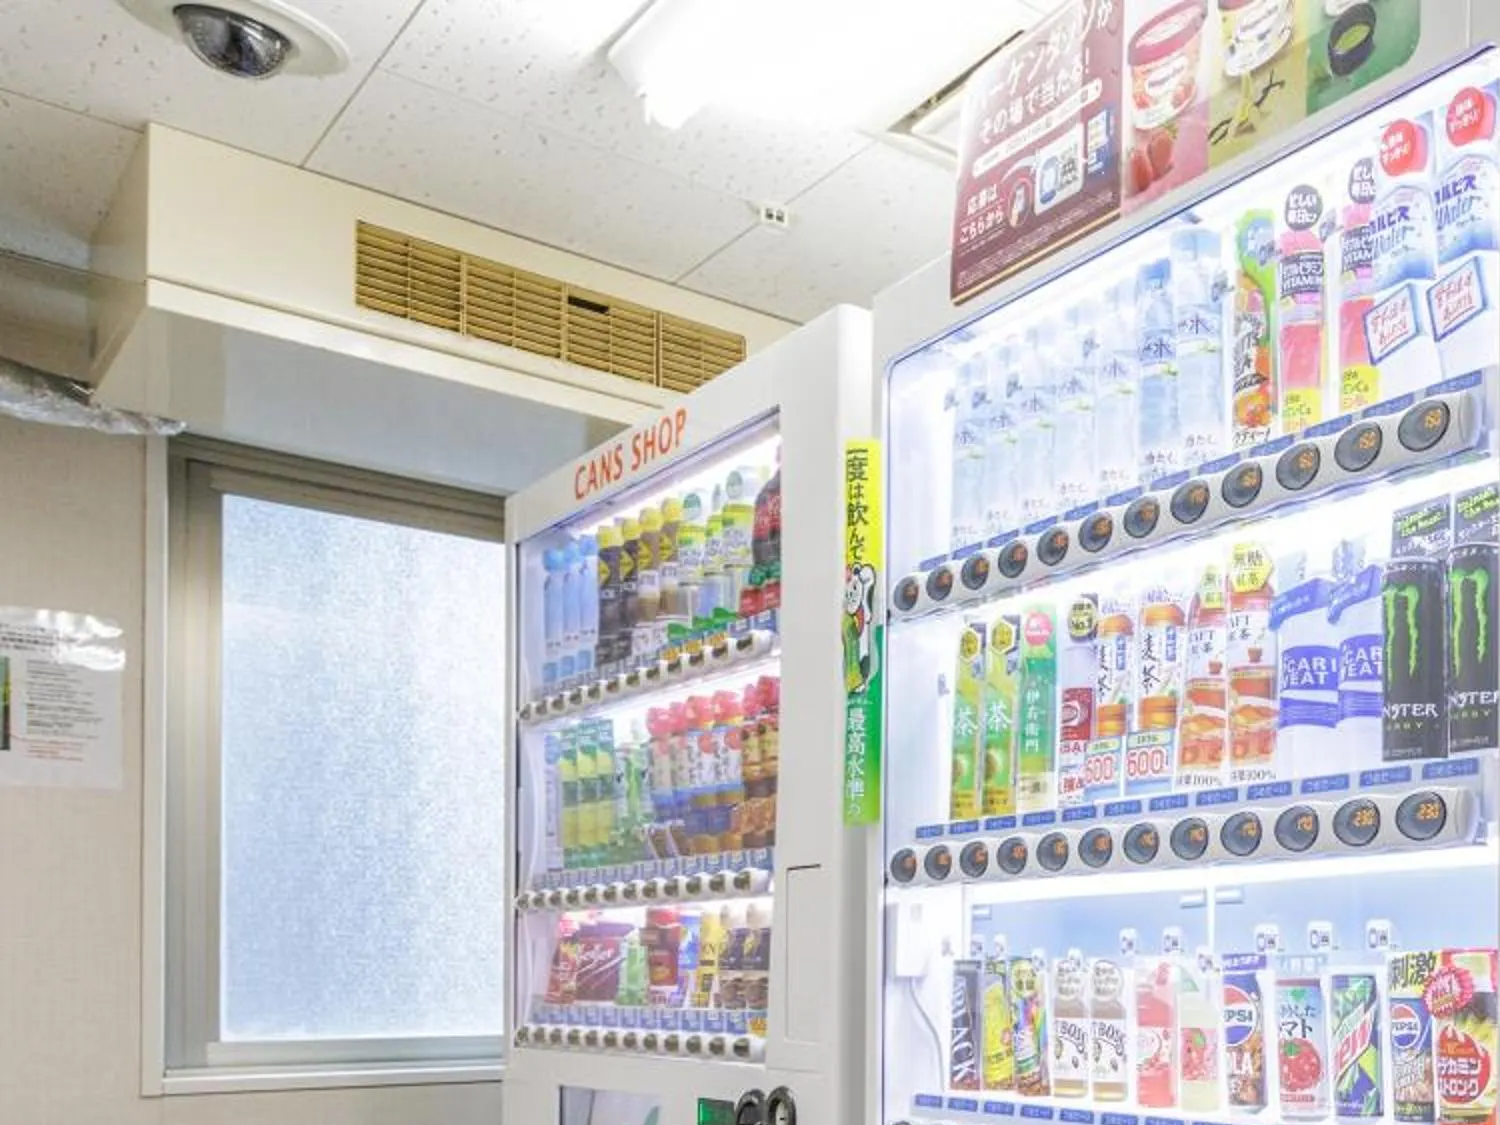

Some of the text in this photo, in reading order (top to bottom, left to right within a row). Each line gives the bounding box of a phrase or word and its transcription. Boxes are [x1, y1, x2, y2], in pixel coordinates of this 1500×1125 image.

[574, 407, 687, 500] CANS SHOP
[847, 448, 869, 560] 一度は飲んで
